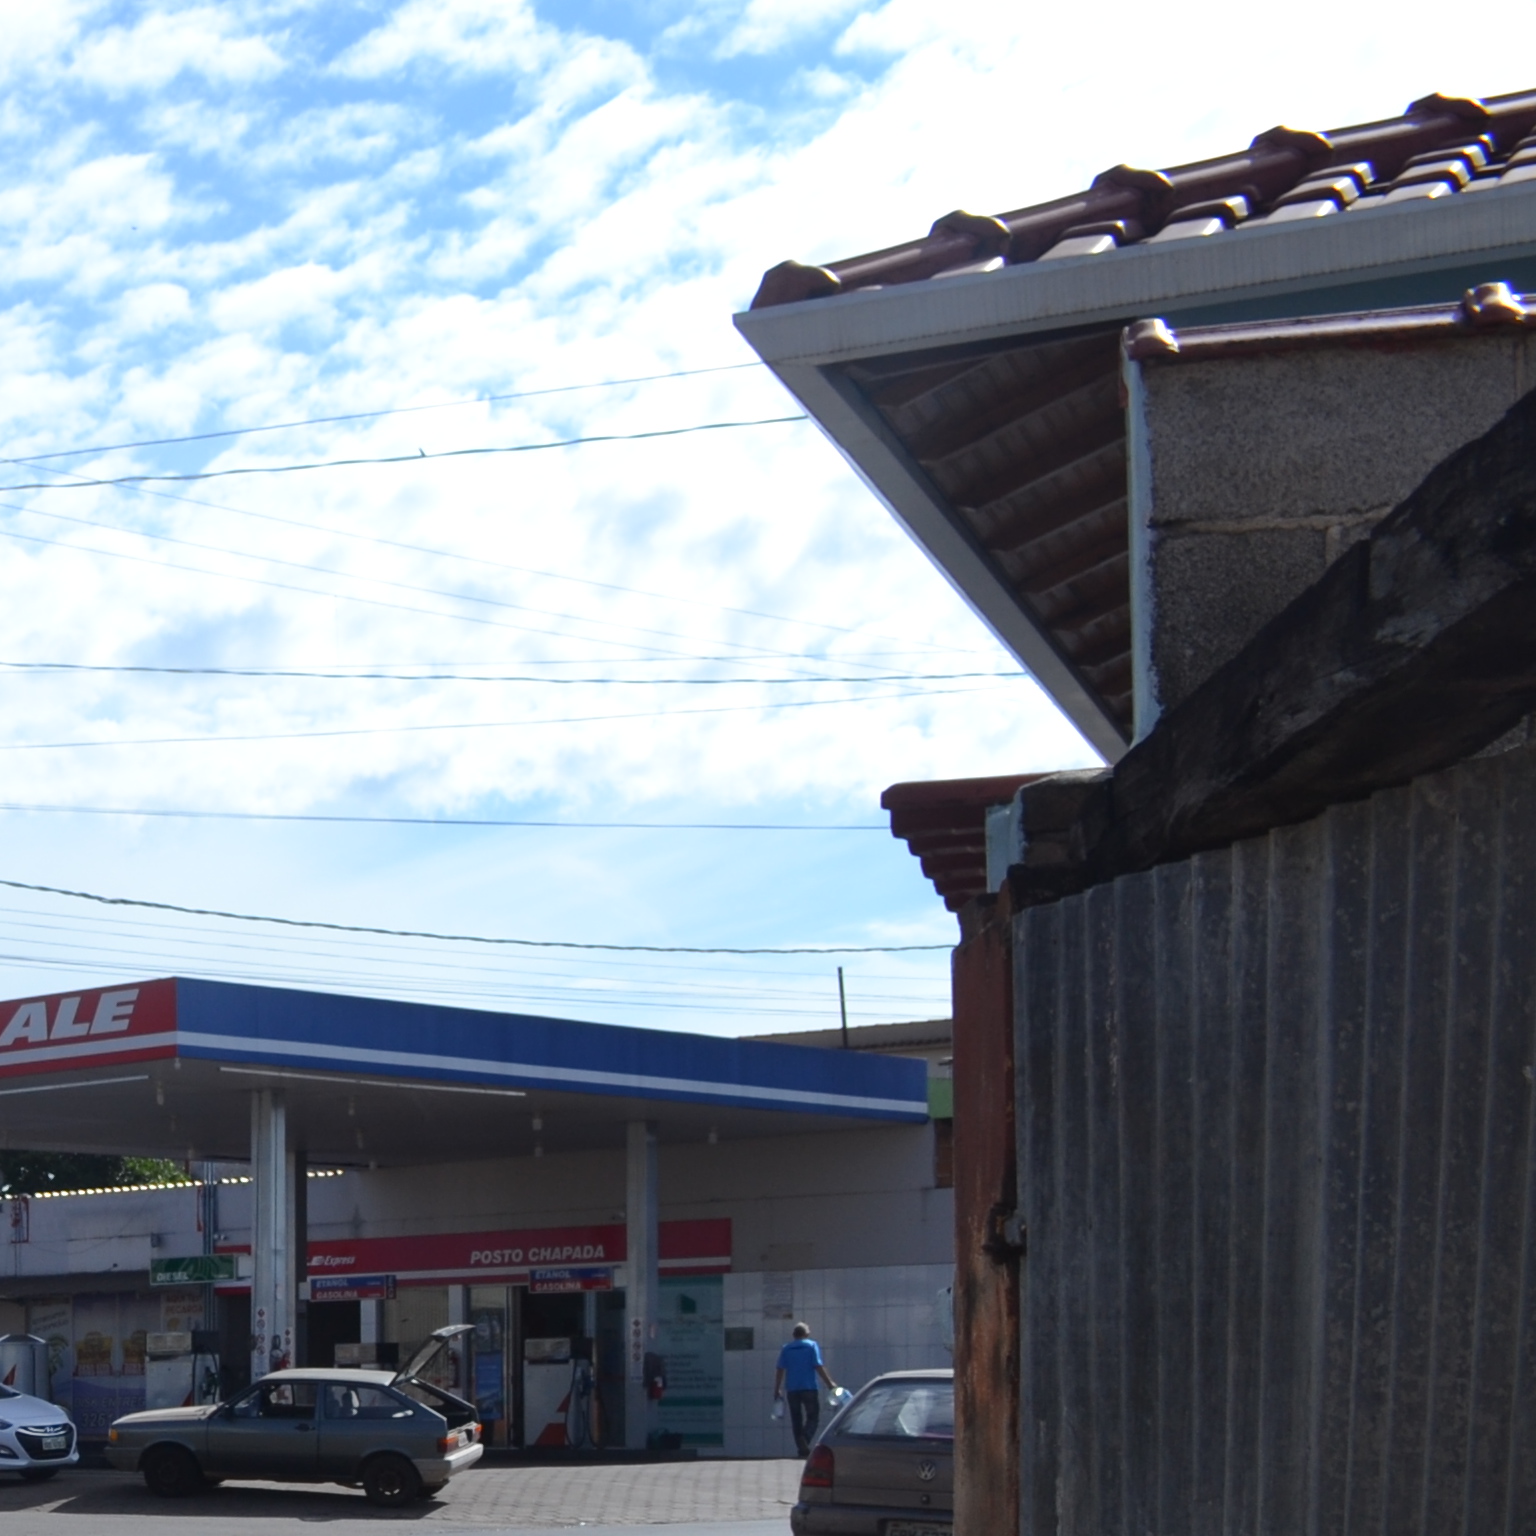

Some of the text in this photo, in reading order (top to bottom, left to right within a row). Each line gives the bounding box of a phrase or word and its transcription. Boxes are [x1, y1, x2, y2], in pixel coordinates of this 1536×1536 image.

[470, 1245, 605, 1265] POSTO CHAPADA
[156, 1272, 190, 1282] DIESEL
[535, 1270, 571, 1280] ETANOL
[315, 1277, 349, 1289] ETANOL
[535, 1281, 582, 1292] GASOLINA
[315, 1290, 358, 1300] GASOLINA
